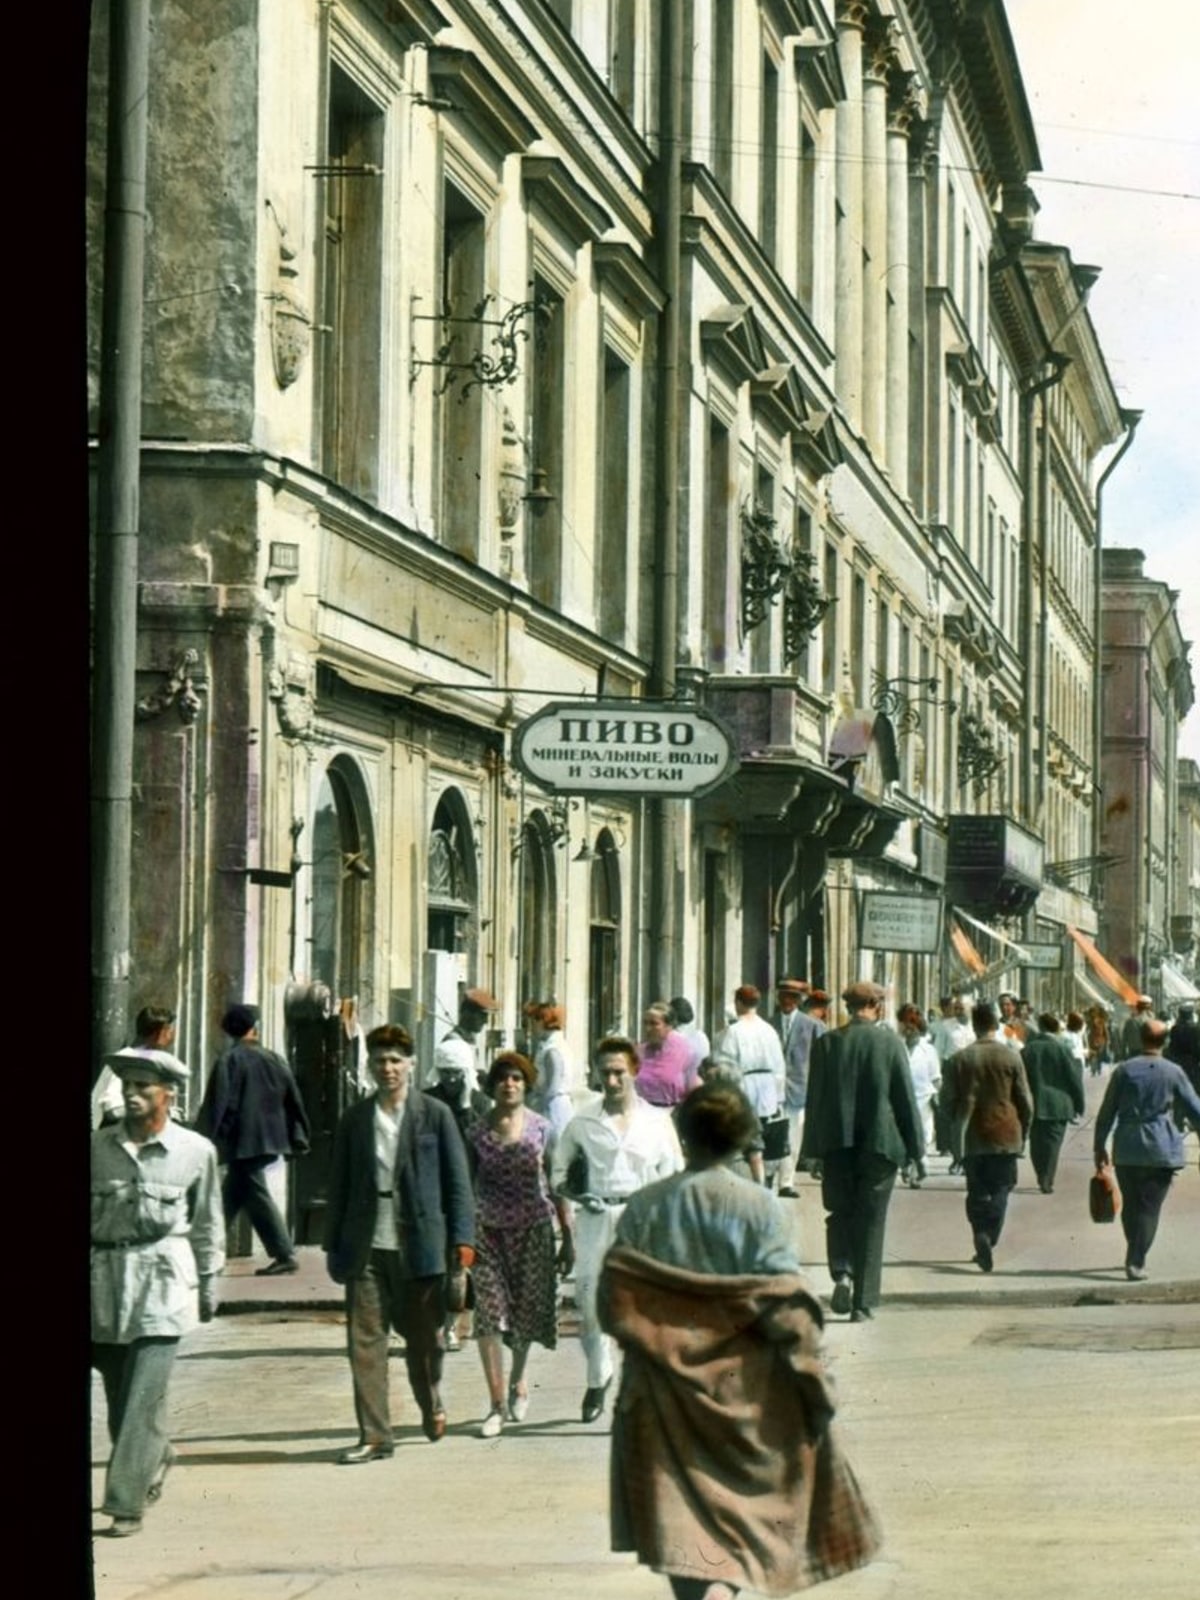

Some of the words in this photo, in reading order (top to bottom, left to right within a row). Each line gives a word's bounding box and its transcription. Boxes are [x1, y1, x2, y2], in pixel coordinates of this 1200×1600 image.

[559, 718, 694, 746] ПИВО
[531, 747, 663, 764] МИНЕРАЛЬНЫЕ
[668, 751, 719, 766] ВОДЫ
